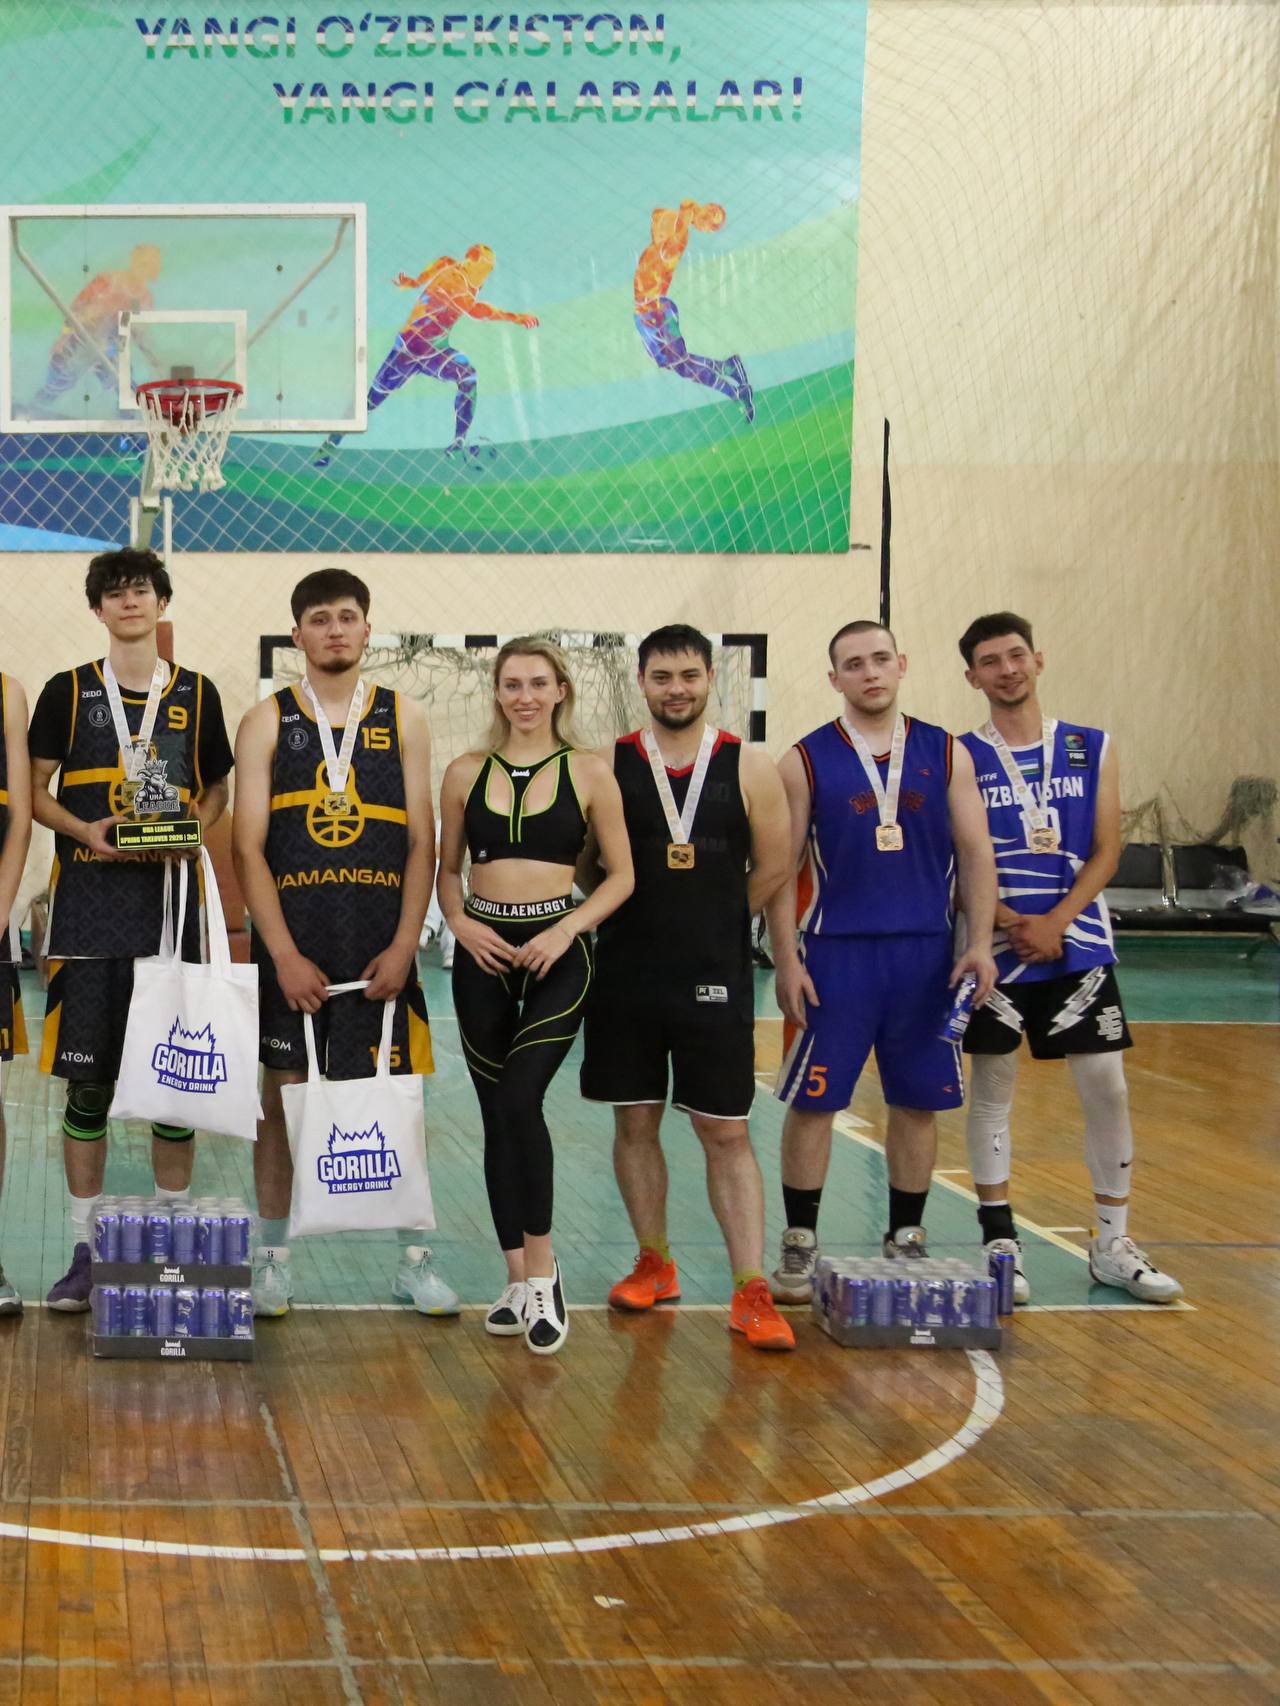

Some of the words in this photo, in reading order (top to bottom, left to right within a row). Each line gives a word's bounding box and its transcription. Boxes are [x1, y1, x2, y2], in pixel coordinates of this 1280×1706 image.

[135, 16, 296, 59] YANGI
[273, 80, 435, 125] YANGI
[168, 705, 188, 730] 9
[361, 727, 391, 750] 15
[472, 898, 568, 916] GORILLAENERGY
[60, 1051, 94, 1064] ATOM
[154, 1045, 225, 1080] GORILLA
[161, 1075, 188, 1090] ENERGY
[188, 1082, 214, 1092] DRINK
[806, 1066, 828, 1097] 5
[320, 1151, 399, 1181] GORILLA
[332, 1182, 363, 1193] ENERGY
[364, 1180, 390, 1190] DRINK
[159, 1274, 185, 1283] GORILLA
[160, 1347, 186, 1356] GORILLA
